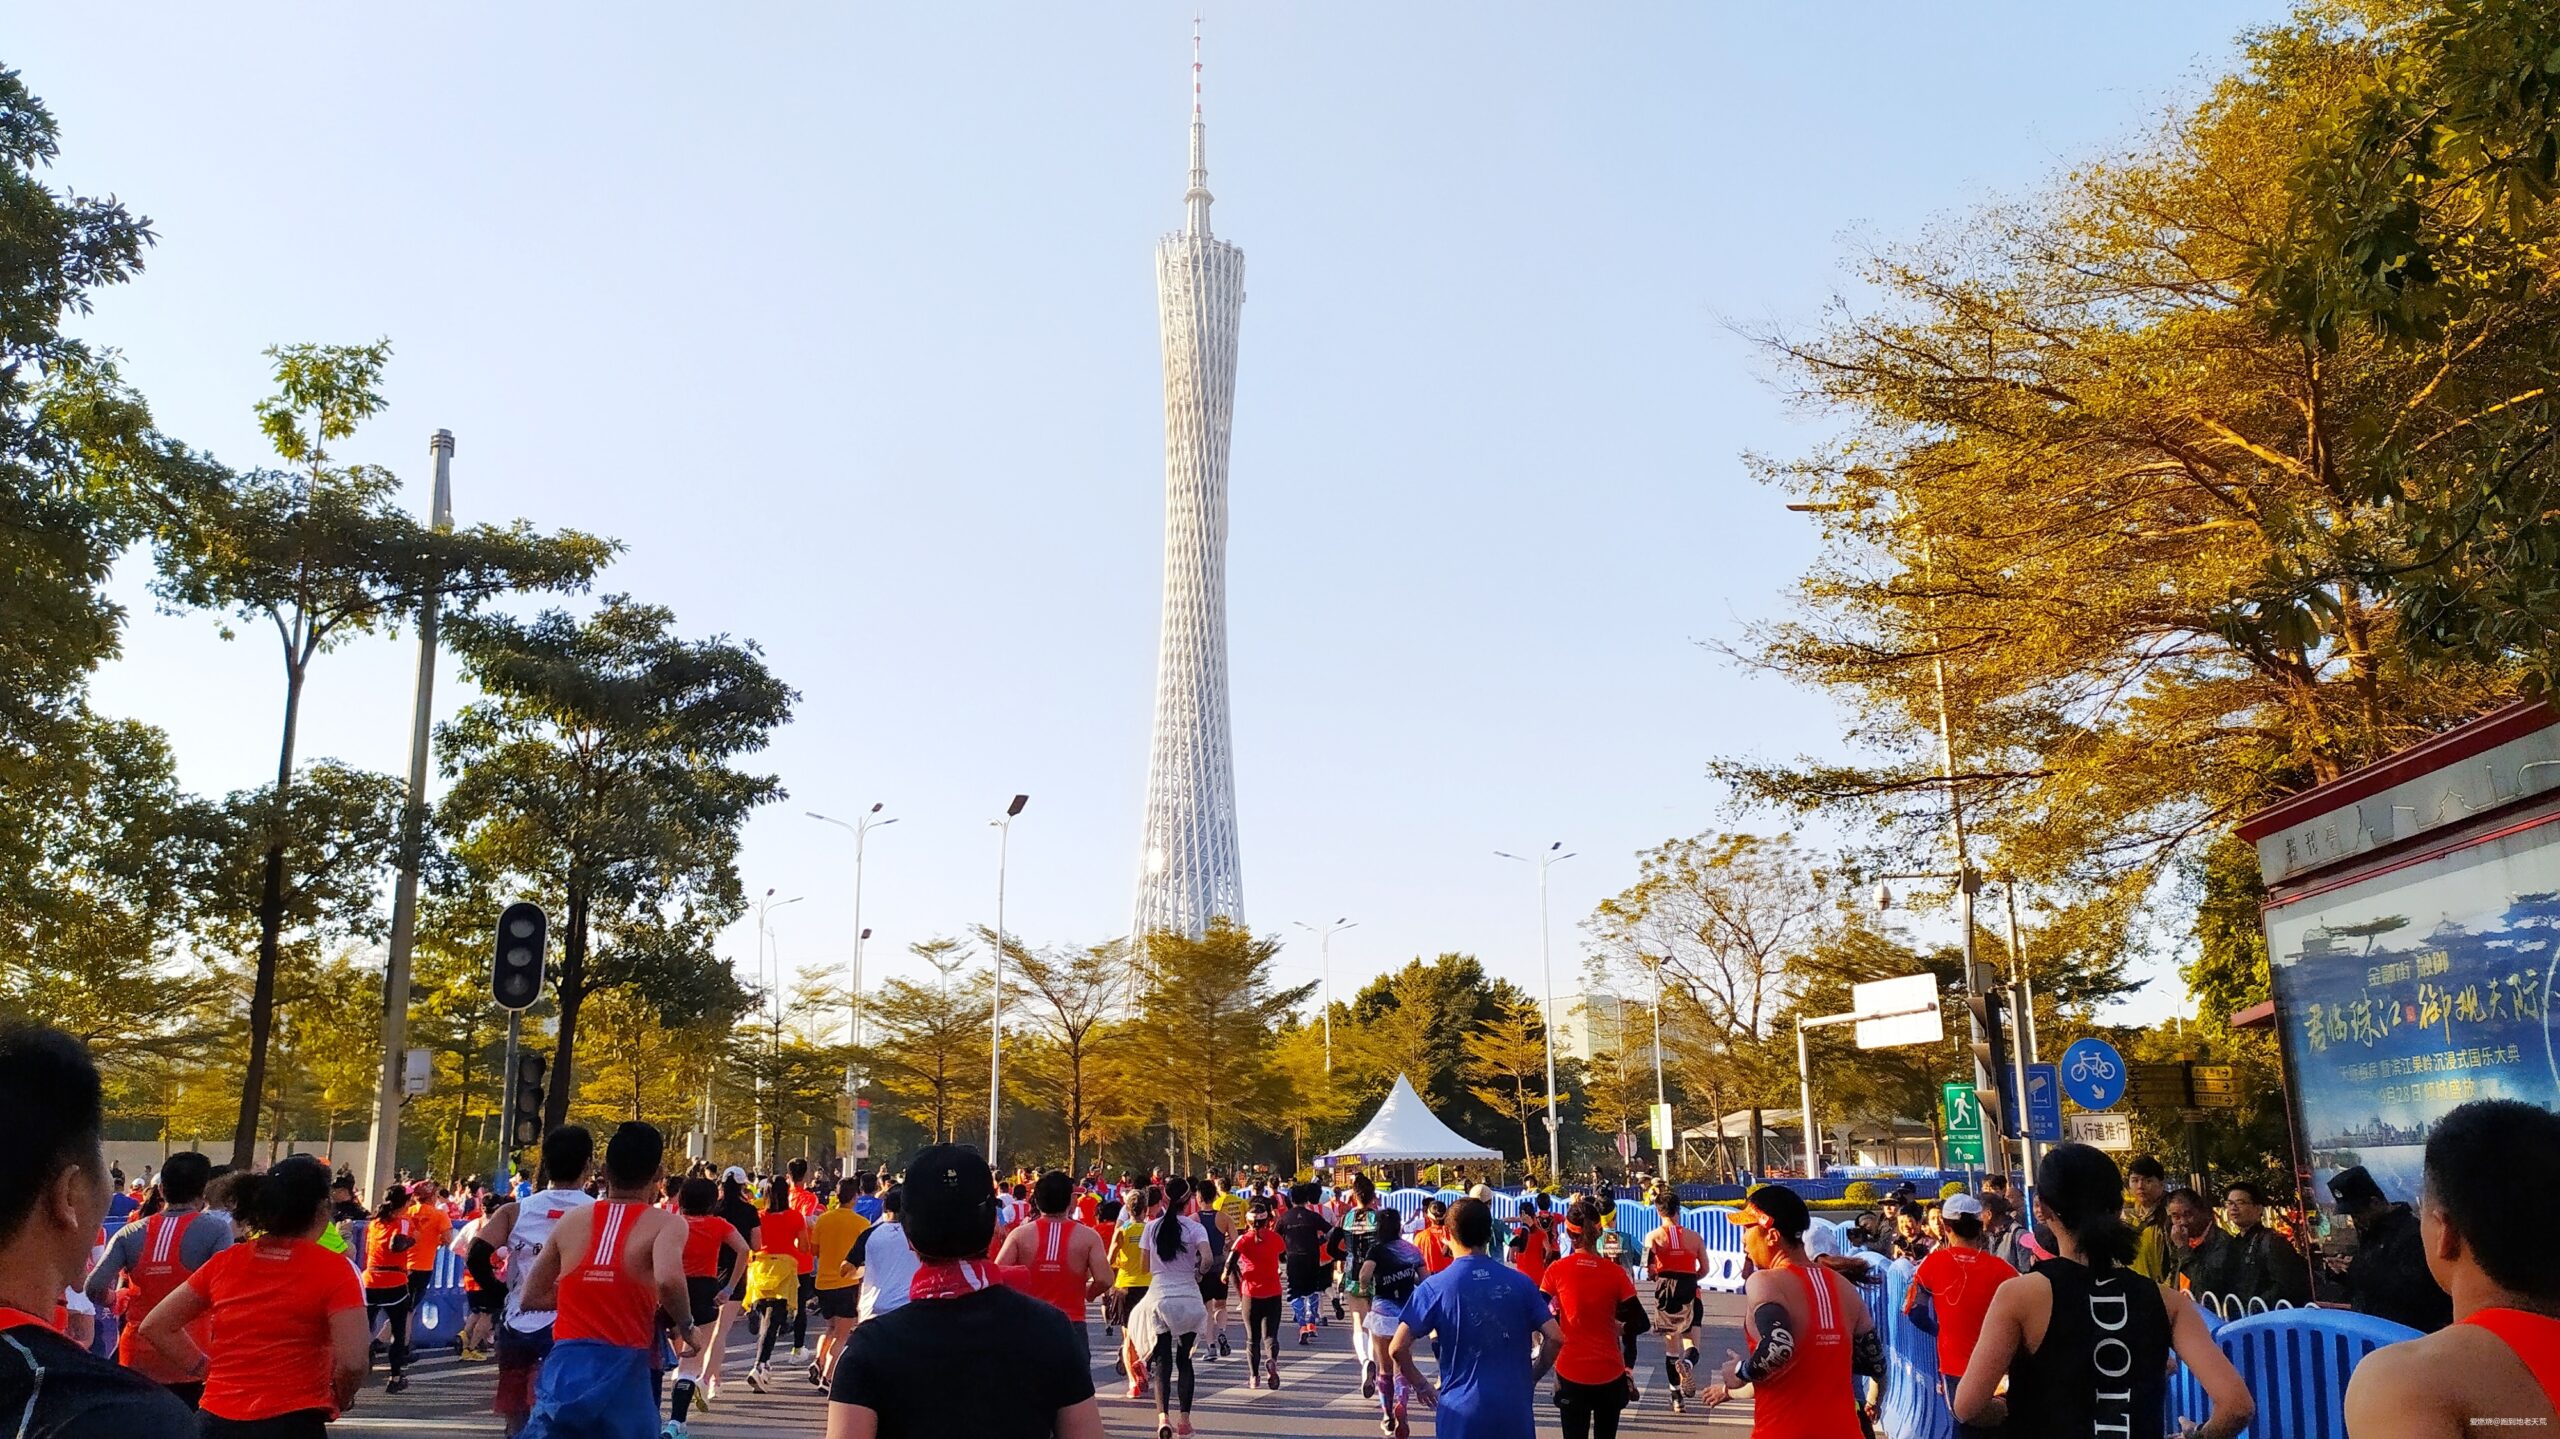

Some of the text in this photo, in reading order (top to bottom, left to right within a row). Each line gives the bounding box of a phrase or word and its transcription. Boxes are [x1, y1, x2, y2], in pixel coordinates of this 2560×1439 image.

[2073, 1122, 2127, 1141] 人行道推行
